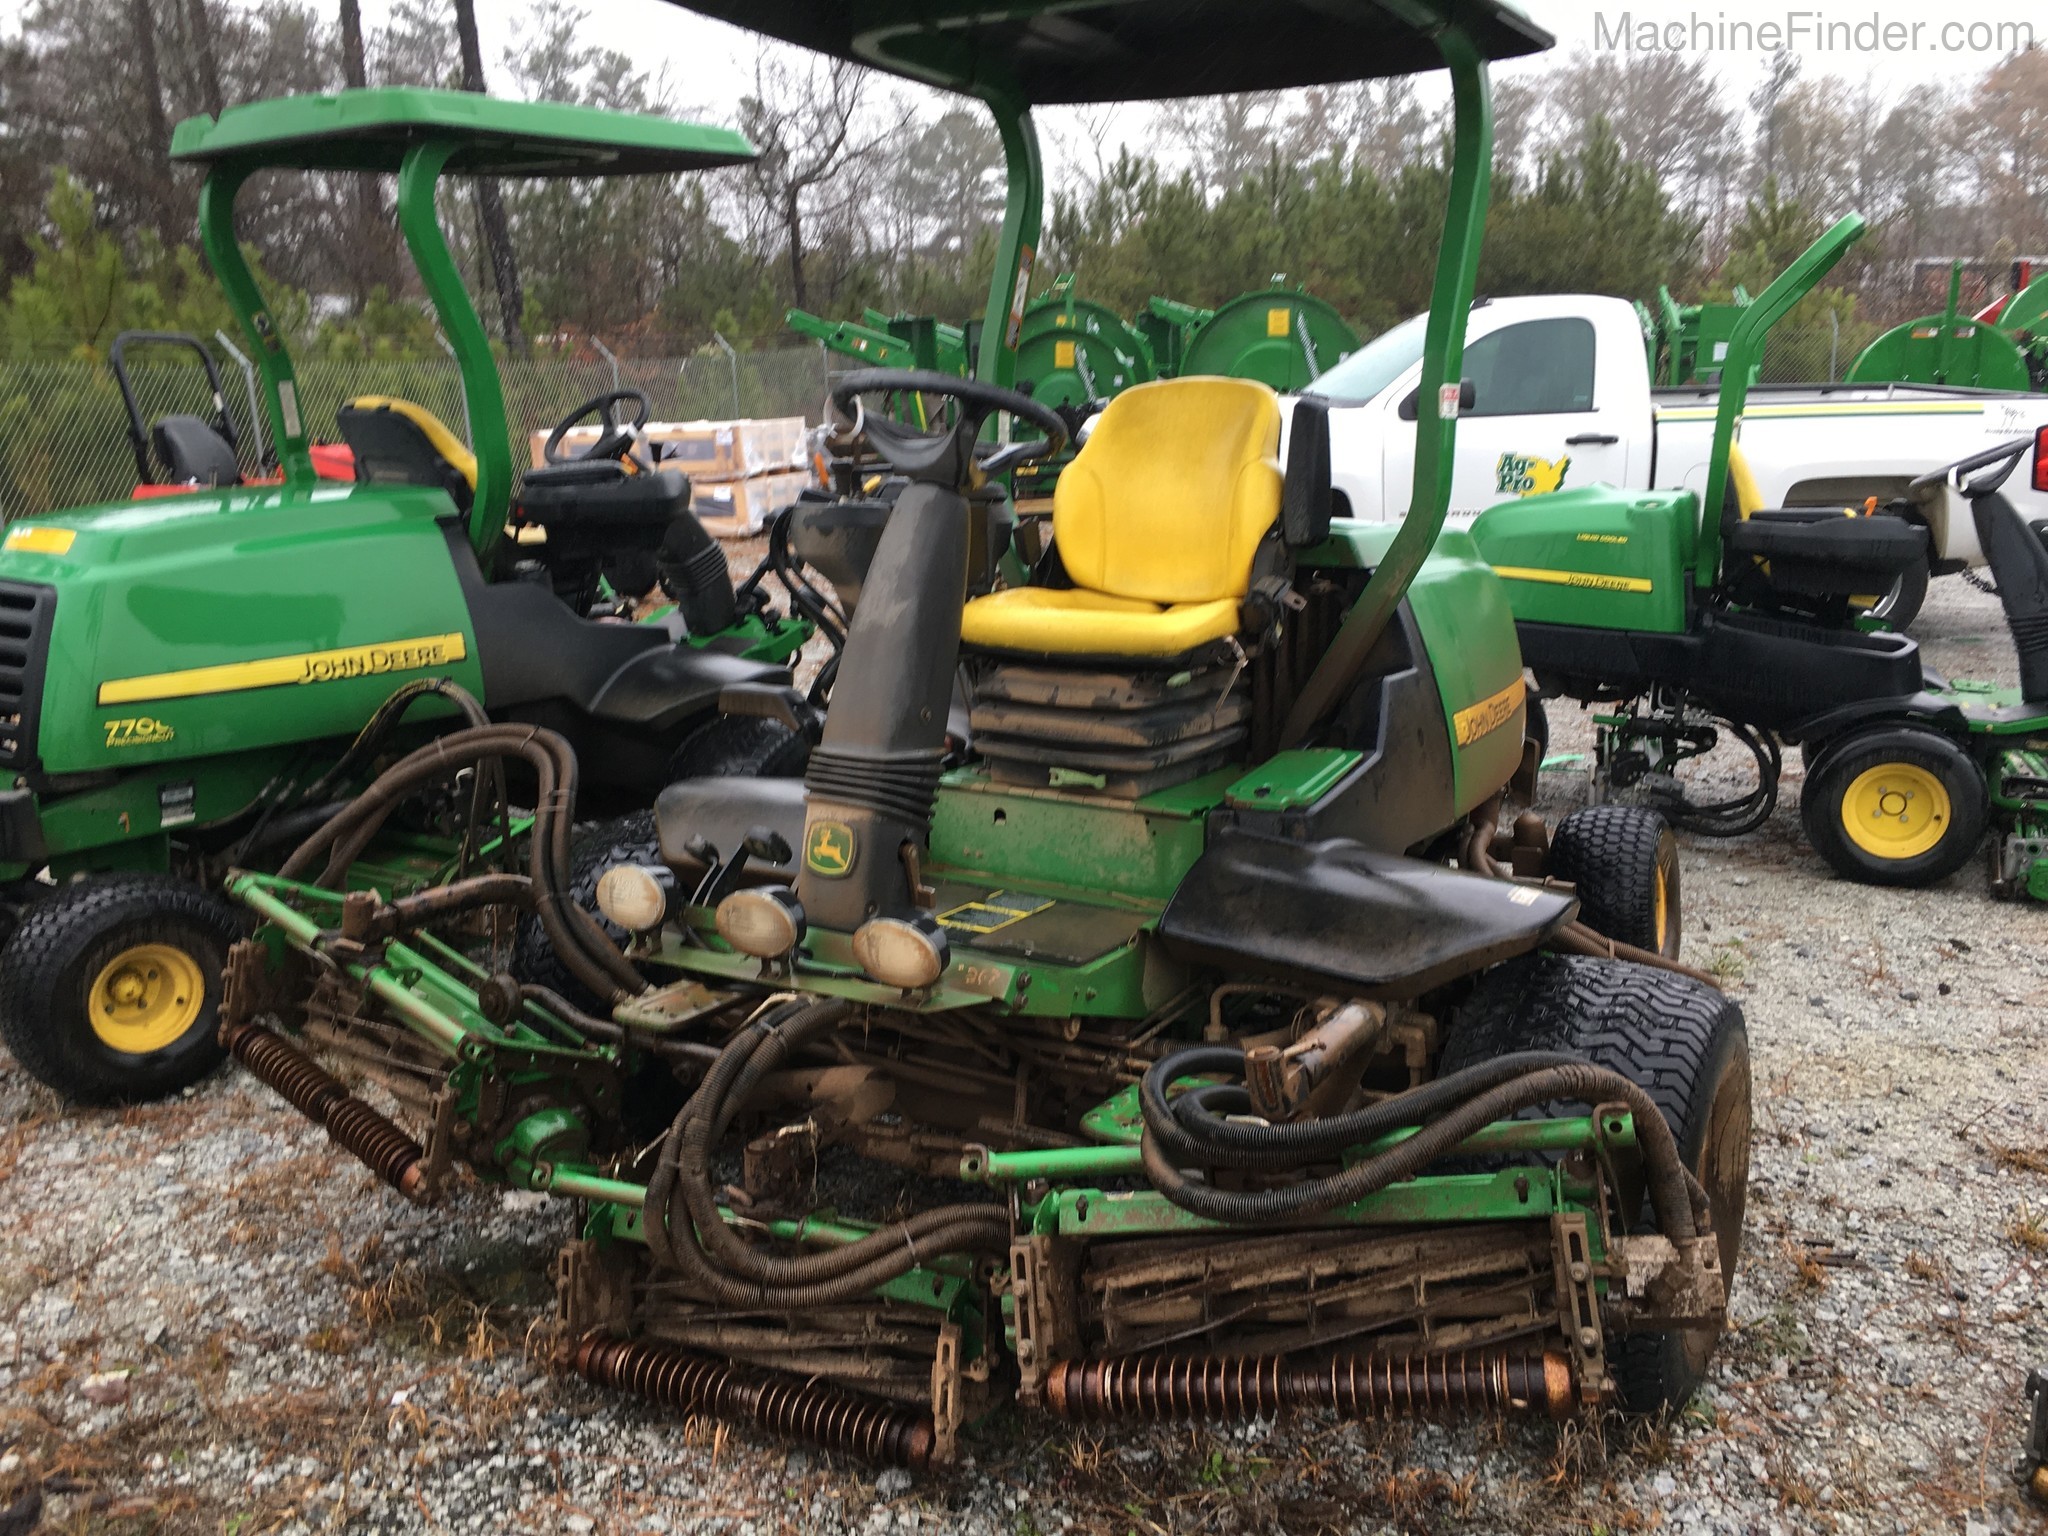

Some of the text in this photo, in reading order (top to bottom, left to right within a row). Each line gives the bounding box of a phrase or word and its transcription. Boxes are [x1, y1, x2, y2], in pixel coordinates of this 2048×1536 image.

[1498, 452, 1535, 476] Ag-
[1497, 474, 1535, 493] Pro
[1567, 573, 1631, 592] JOHN DEERE
[298, 644, 445, 684] JOHN DEERE
[1465, 695, 1513, 745] JOHN DEERE
